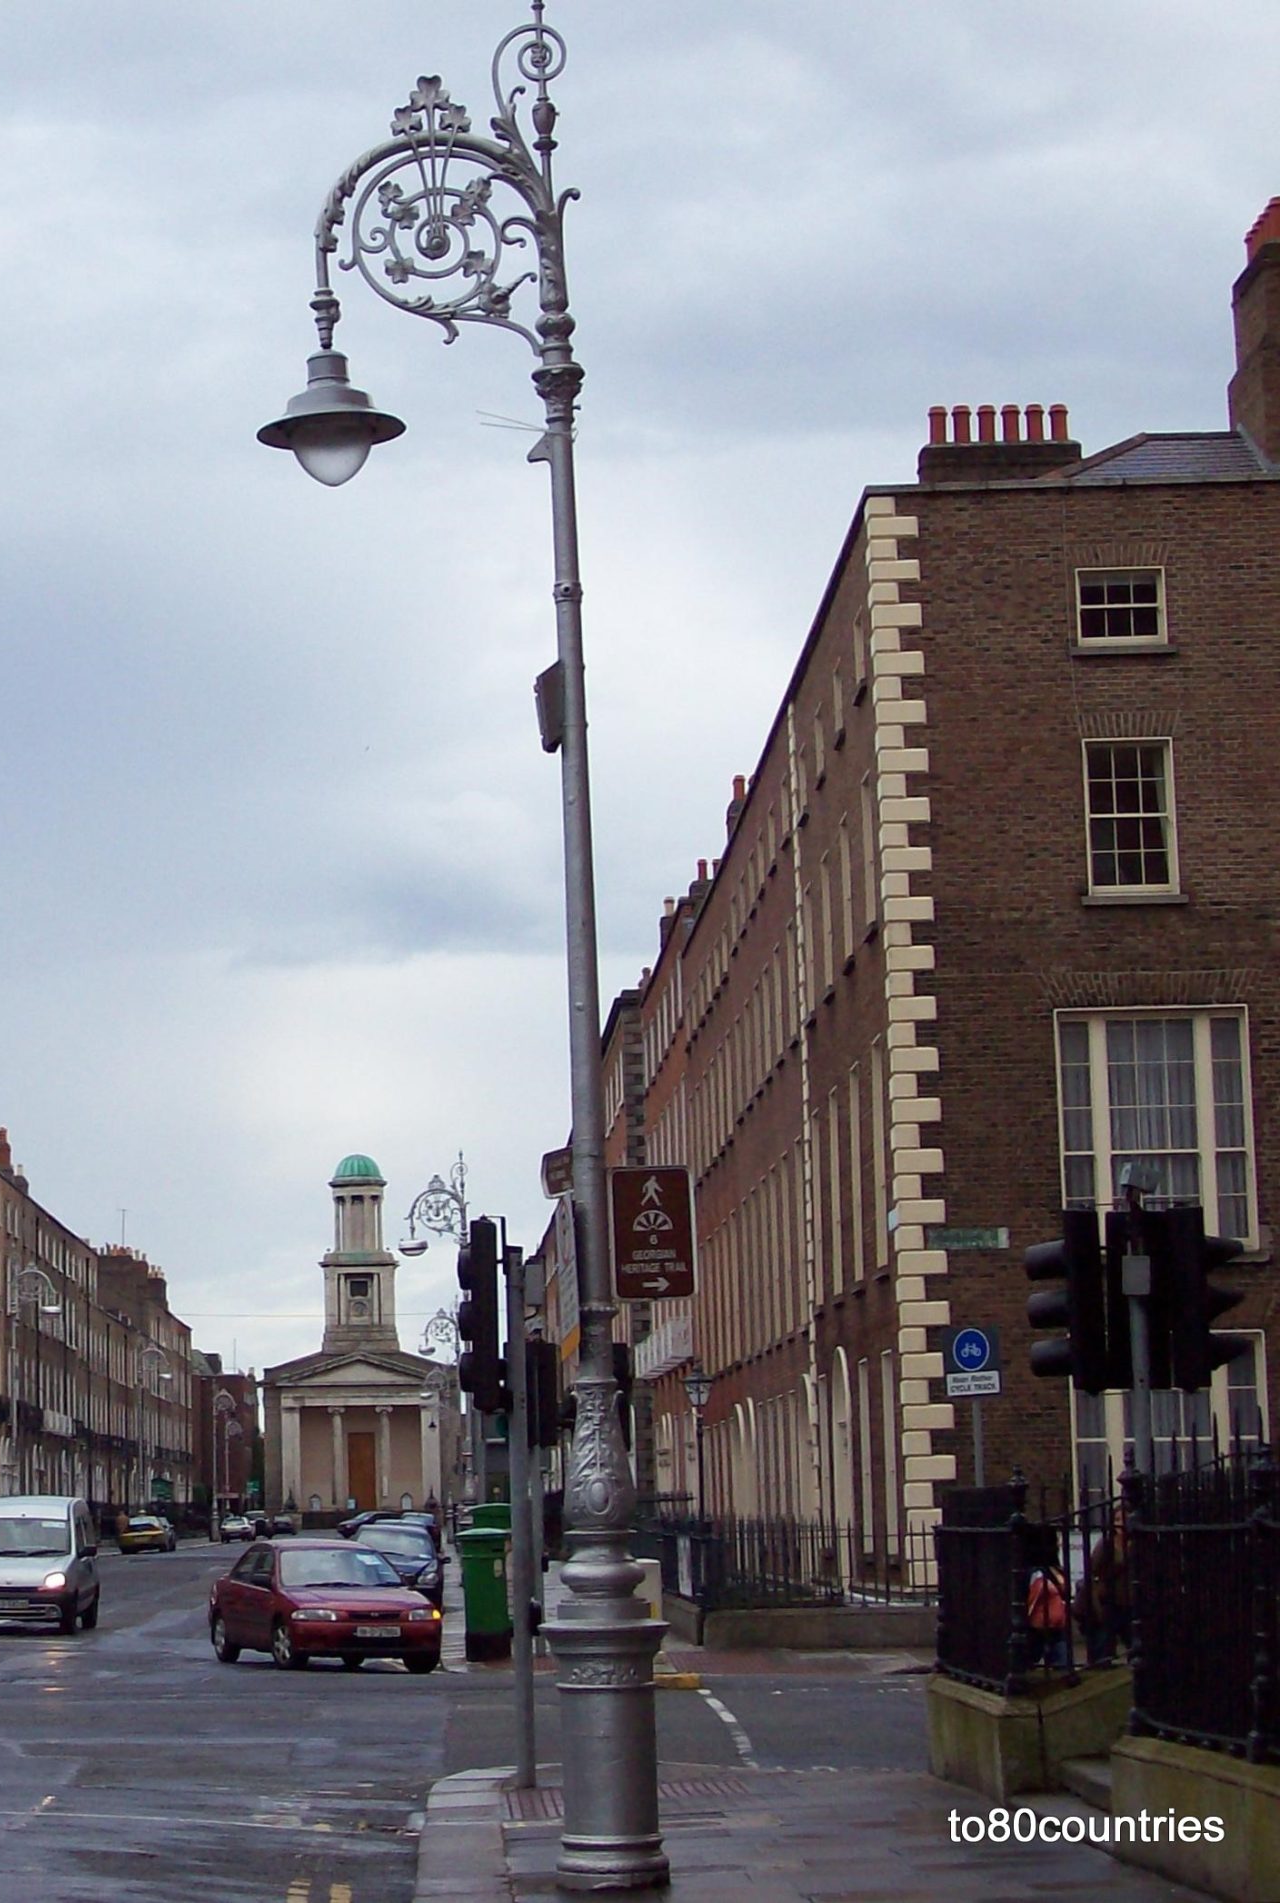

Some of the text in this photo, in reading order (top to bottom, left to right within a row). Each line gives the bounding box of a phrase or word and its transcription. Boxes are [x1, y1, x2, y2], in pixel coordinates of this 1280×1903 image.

[649, 1234, 658, 1245] 6
[632, 1249, 677, 1260] GEORGIAN
[621, 1261, 689, 1274] HERITAGE TRAIL
[950, 1382, 997, 1394] CYCLE TRACK
